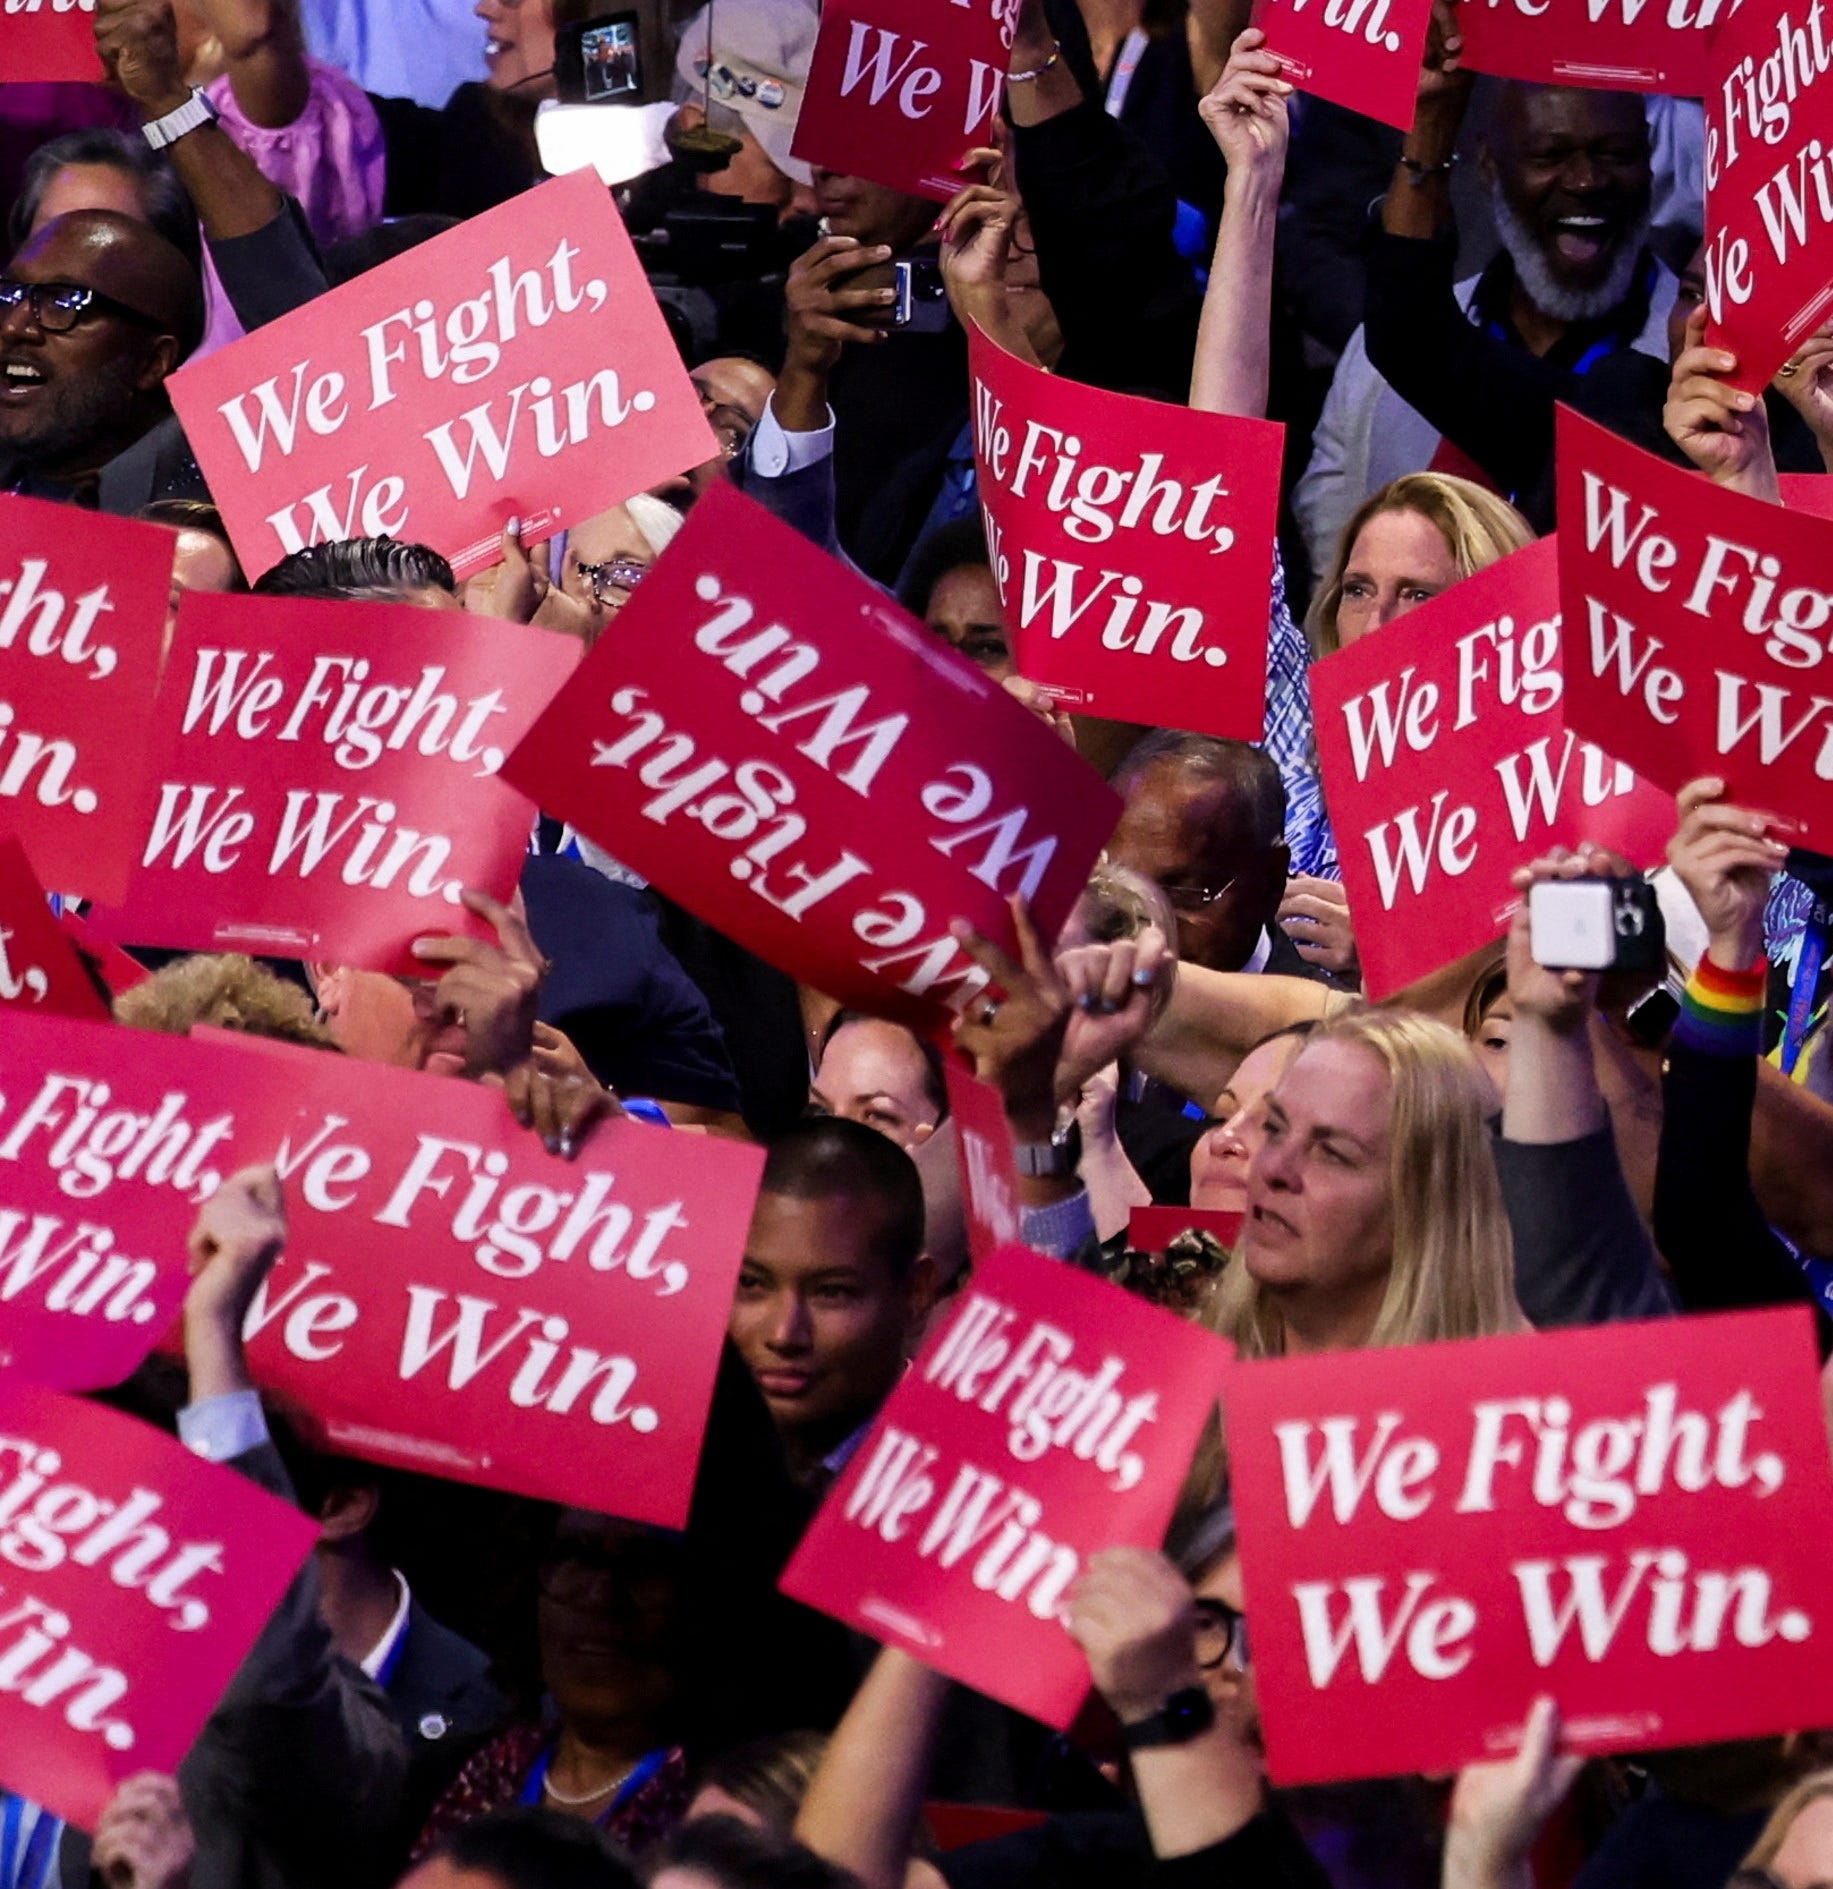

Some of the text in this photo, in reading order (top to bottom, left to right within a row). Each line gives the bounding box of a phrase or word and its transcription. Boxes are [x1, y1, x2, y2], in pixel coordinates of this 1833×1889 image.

[218, 238, 607, 472] We Fight,
[423, 369, 655, 499] Win.
[1011, 420, 1234, 553] Fight,
[1583, 471, 1676, 592] We
[1021, 550, 1227, 666] Win.
[1586, 596, 1683, 723] We
[183, 649, 505, 780] We Fight,
[695, 575, 1056, 912] We Win.
[143, 784, 464, 904] We Win.
[592, 688, 874, 920] Fight,
[1275, 1383, 1783, 1528] We Fight,
[1293, 1549, 1809, 1688] We Win.
